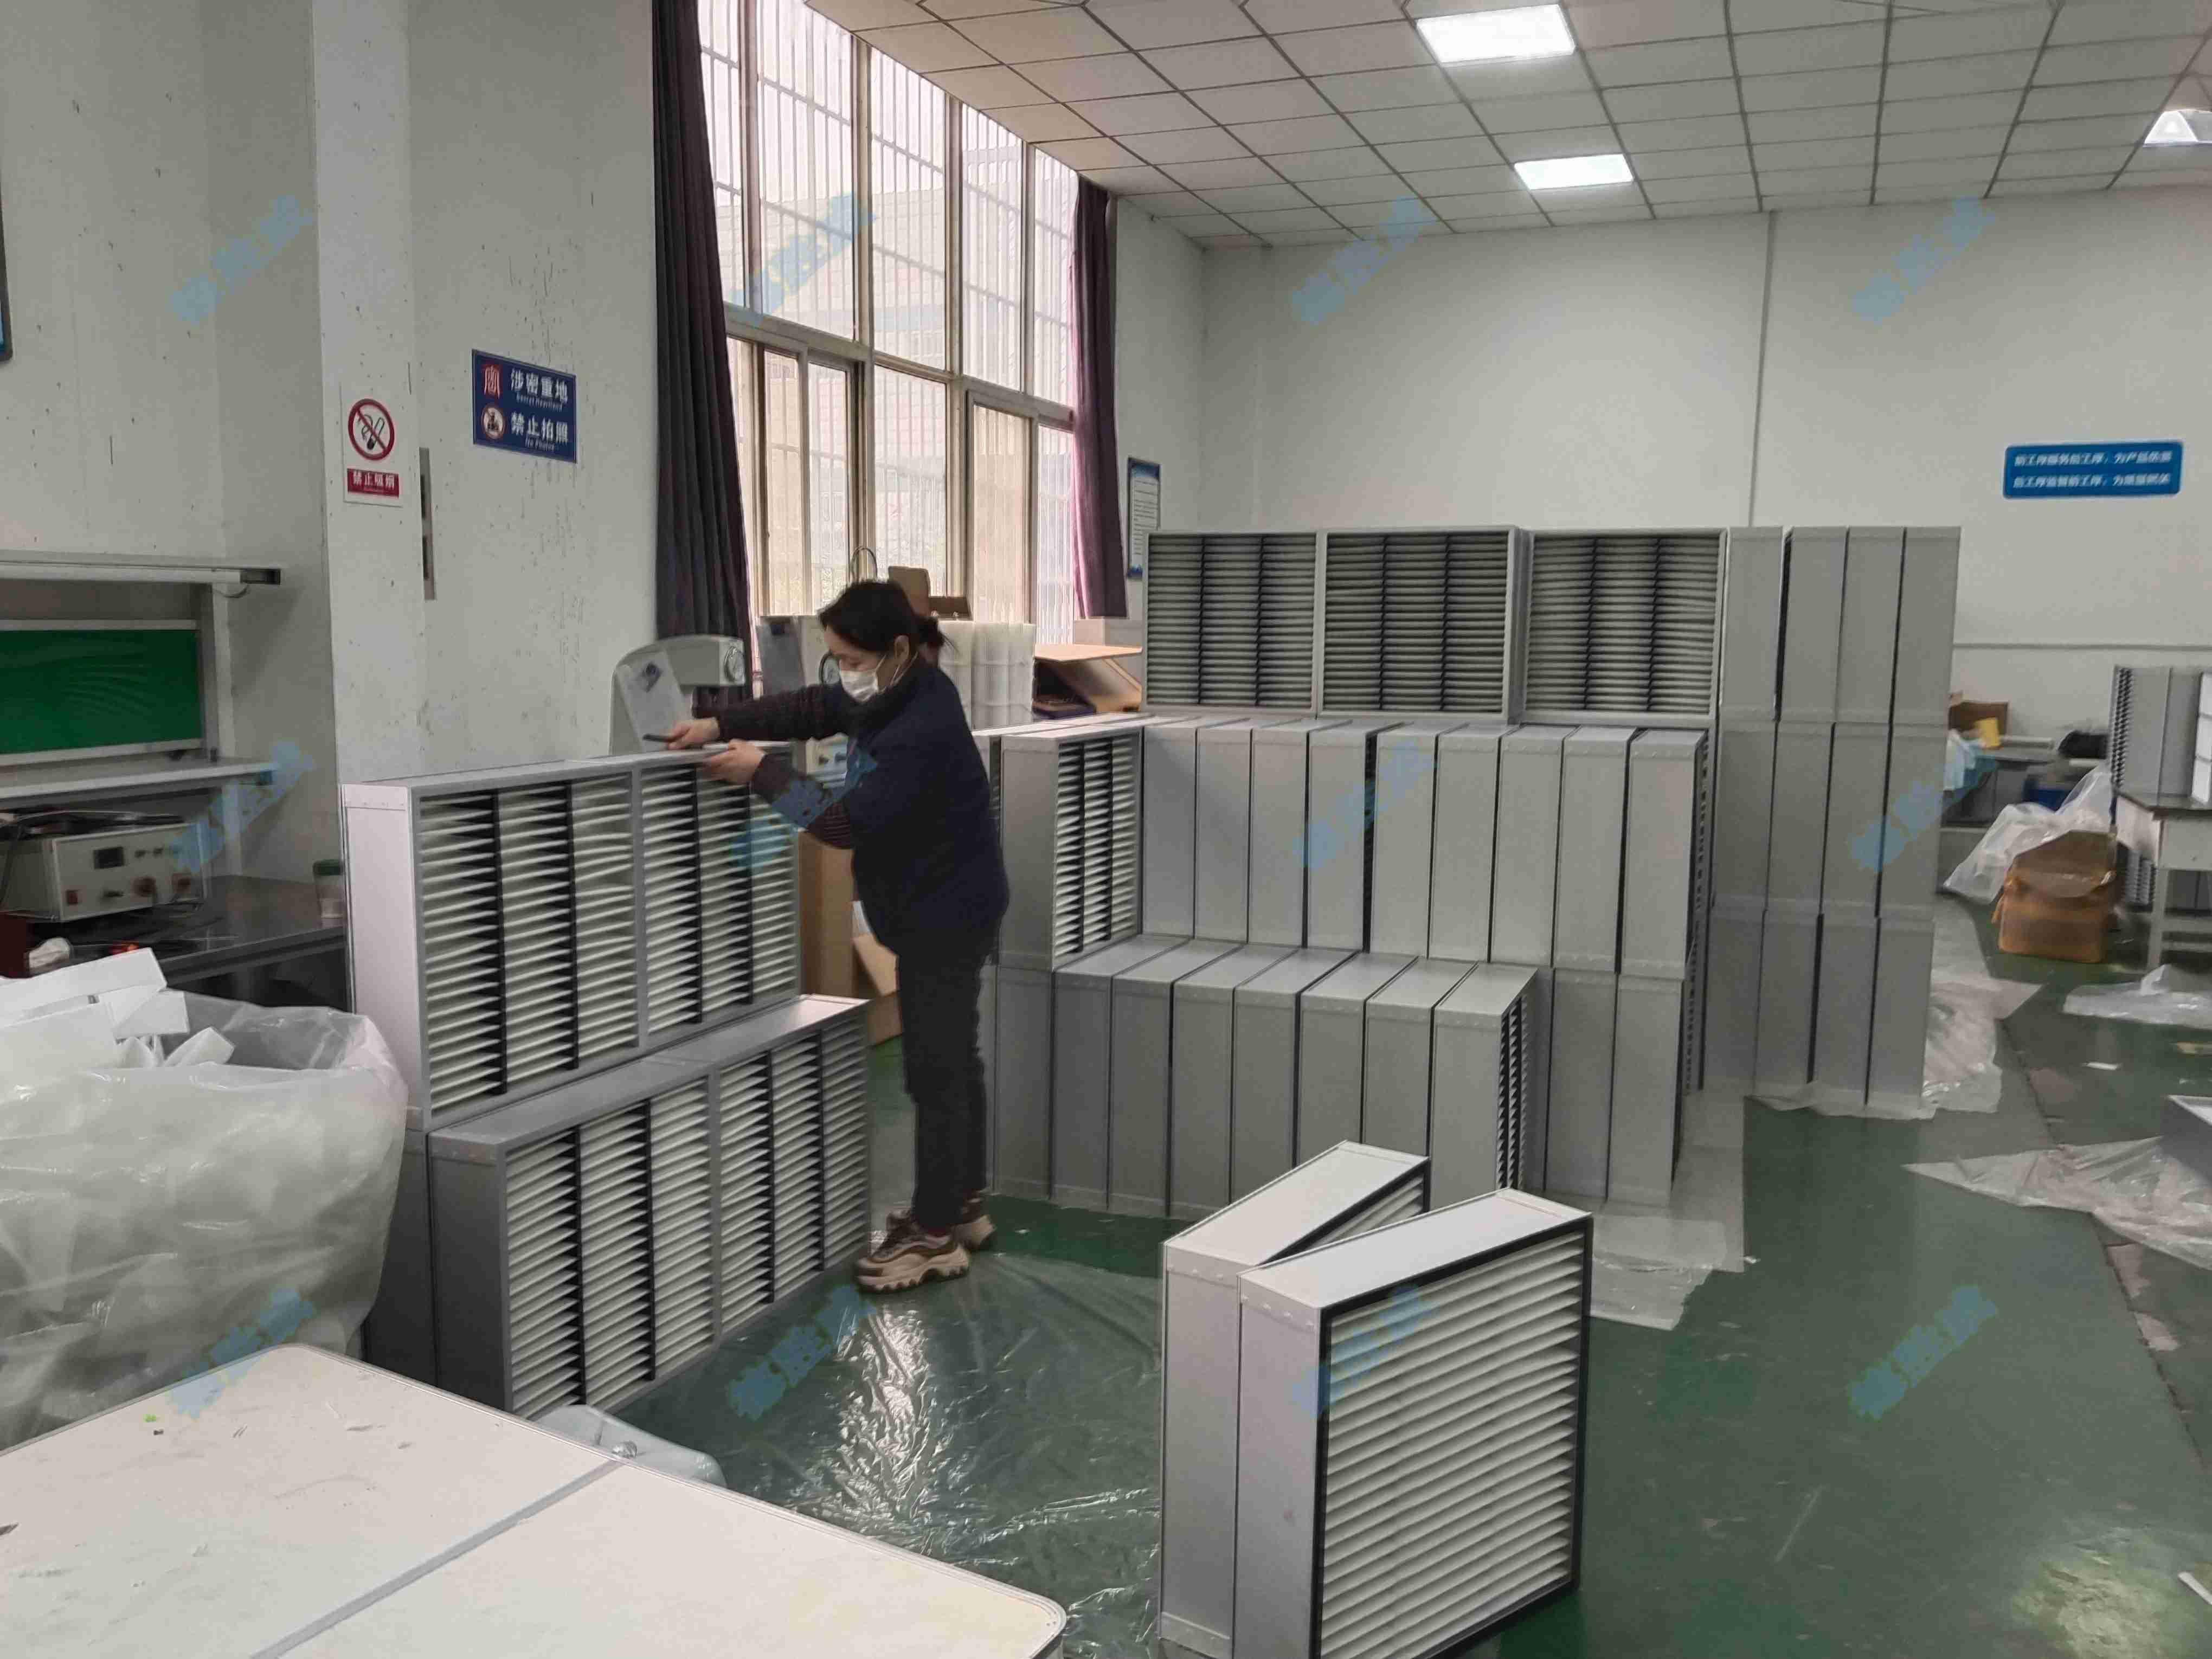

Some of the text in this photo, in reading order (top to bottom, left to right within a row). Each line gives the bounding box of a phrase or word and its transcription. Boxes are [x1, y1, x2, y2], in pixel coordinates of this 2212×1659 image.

[511, 368, 568, 404] 涉密重地
[511, 411, 568, 446] 禁止拍照
[353, 471, 395, 490] 禁止吸烟
